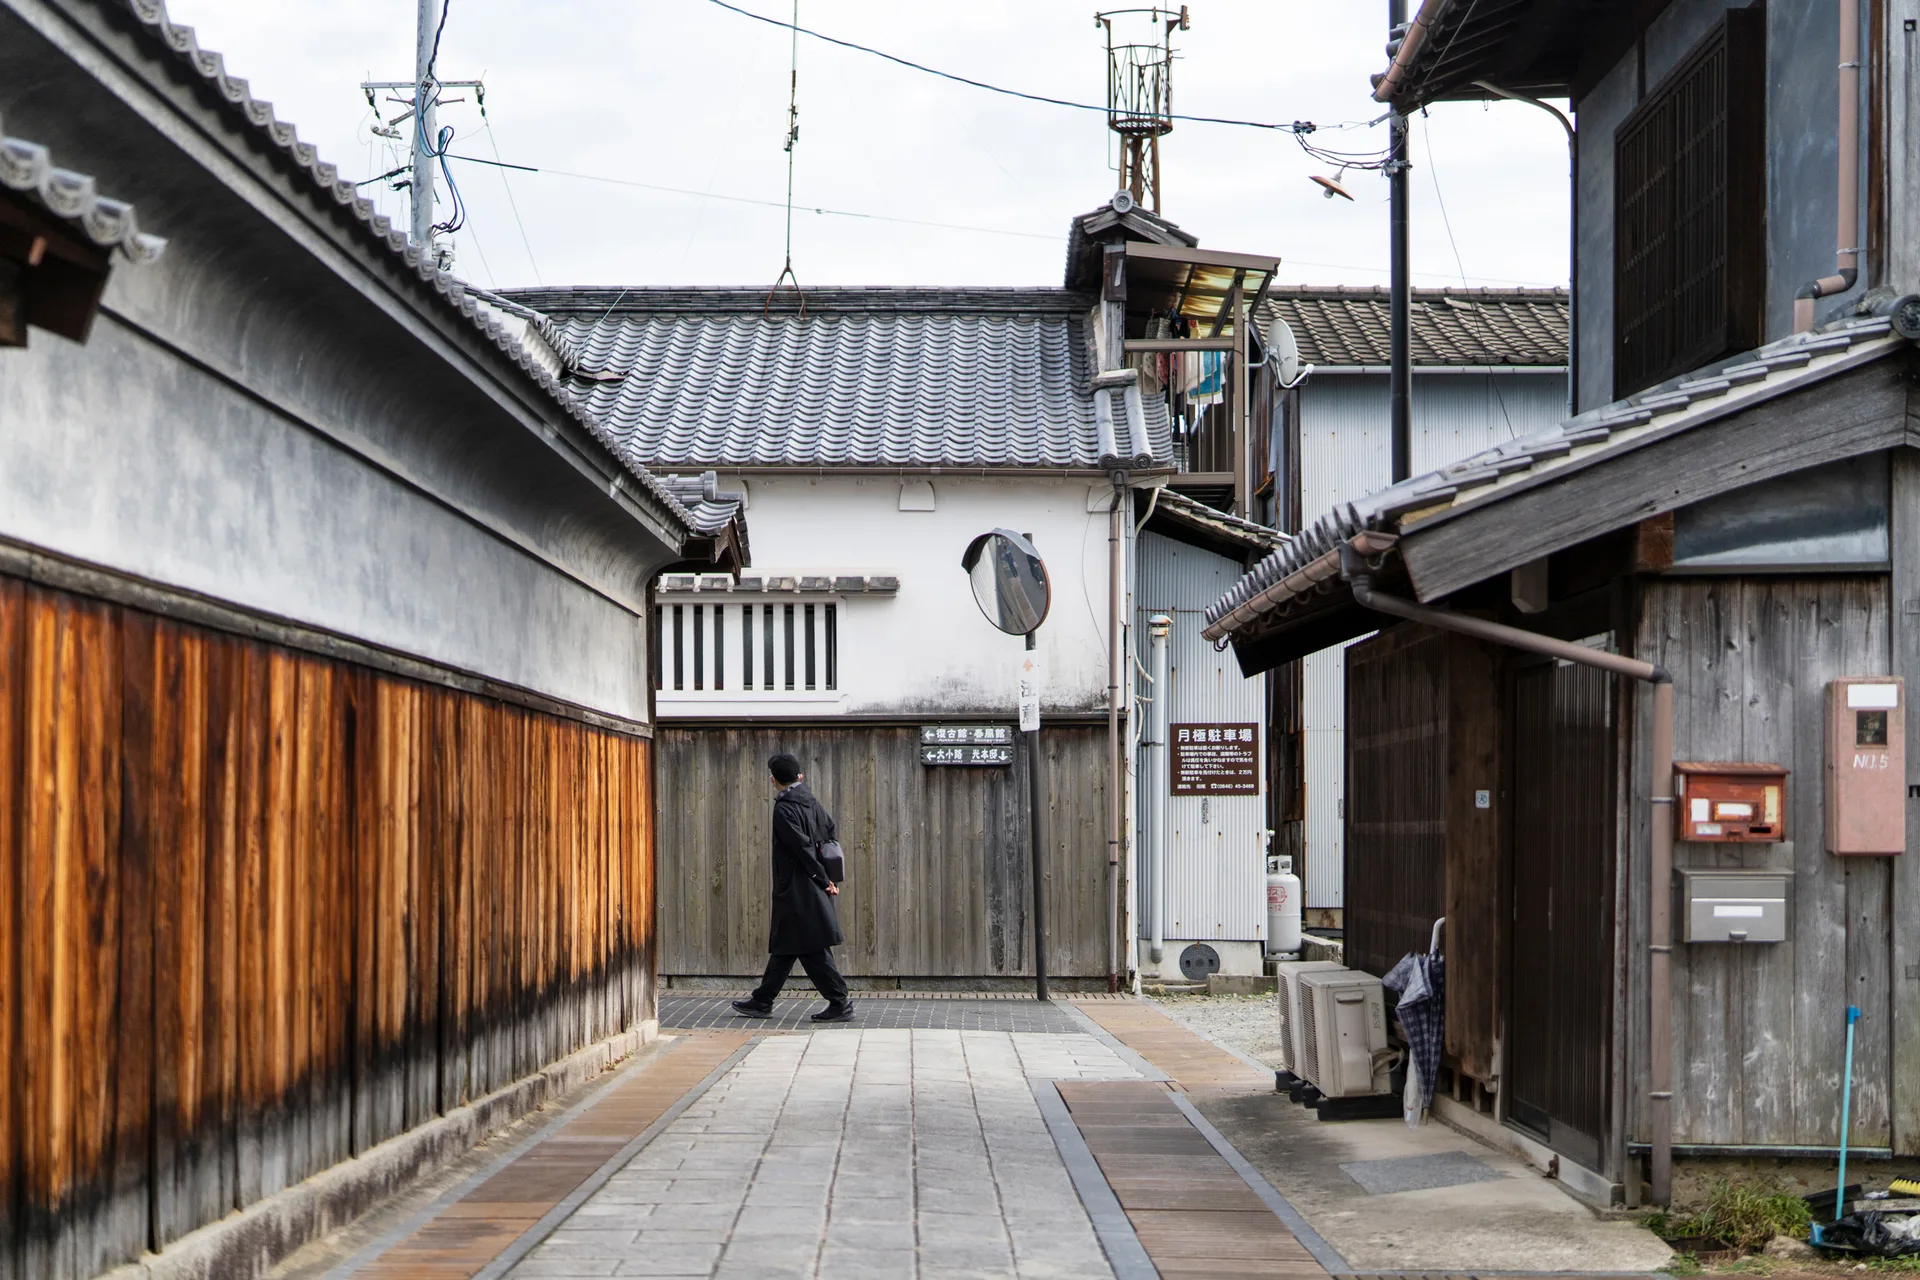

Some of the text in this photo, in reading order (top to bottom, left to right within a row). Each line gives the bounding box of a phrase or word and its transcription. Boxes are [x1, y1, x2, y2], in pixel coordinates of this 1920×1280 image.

[1177, 728, 1253, 742] 月極駐車場
[936, 749, 962, 760] 大小路
